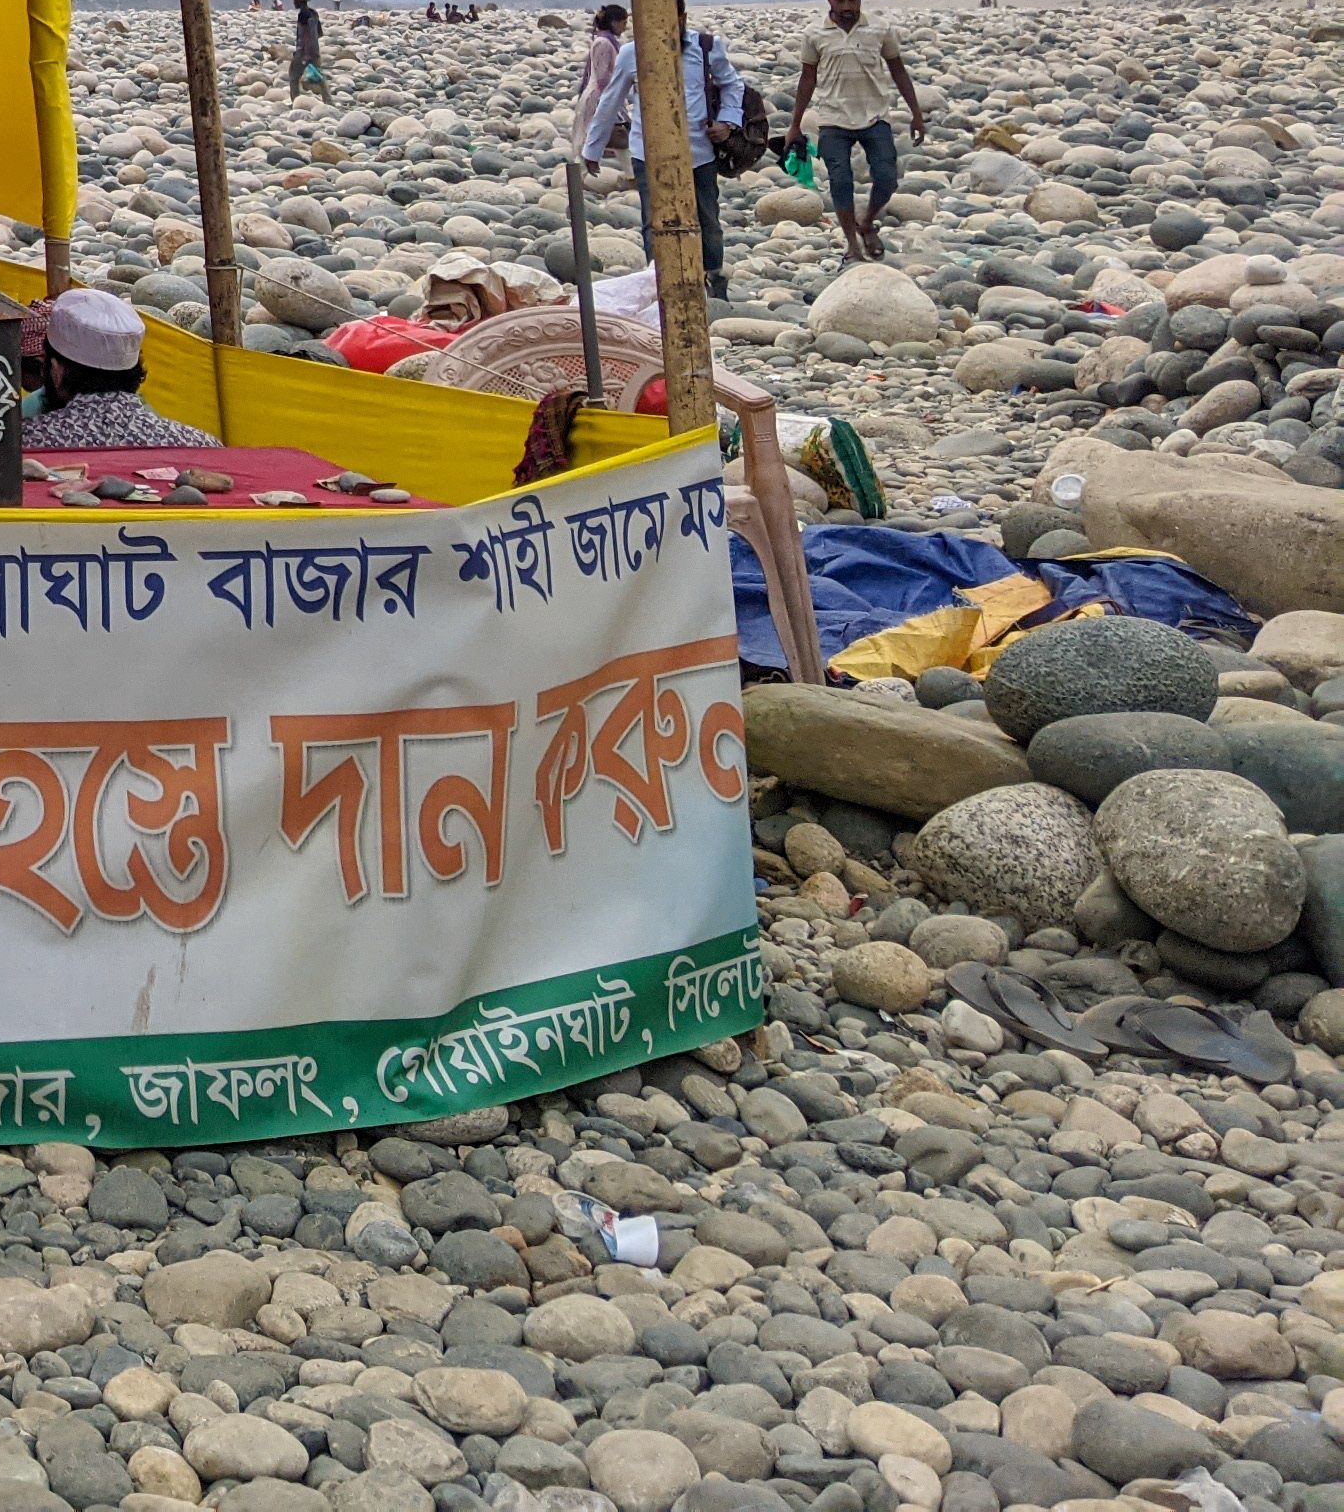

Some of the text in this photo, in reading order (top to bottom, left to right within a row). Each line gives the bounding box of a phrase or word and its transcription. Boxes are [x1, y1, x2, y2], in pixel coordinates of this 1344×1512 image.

[202, 534, 432, 631] বাজার
[451, 494, 555, 614] শাহী
[564, 492, 671, 584] জামে
[269, 700, 518, 908] দান
